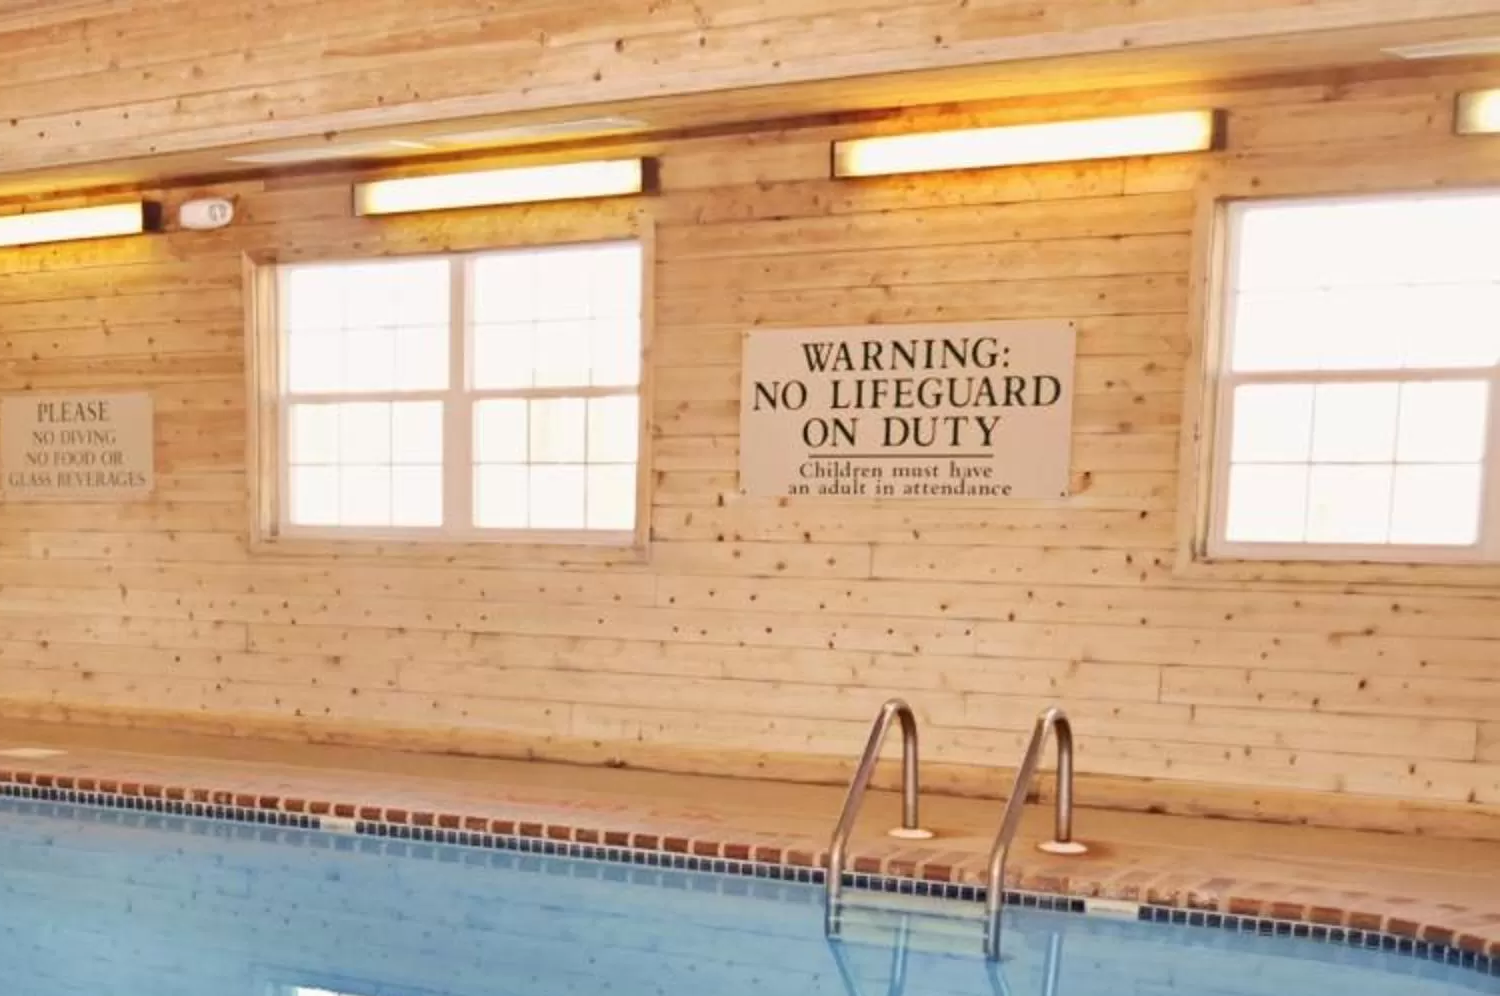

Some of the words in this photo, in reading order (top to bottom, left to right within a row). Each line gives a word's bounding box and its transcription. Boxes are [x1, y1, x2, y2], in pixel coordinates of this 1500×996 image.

[802, 337, 1010, 373] WARNING:
[753, 380, 807, 411] NO
[830, 375, 1061, 410] LIFEGUARD
[37, 401, 110, 423] PLEASE
[32, 430, 55, 445] NO
[60, 429, 117, 445] DIVING
[802, 416, 859, 448] ON
[882, 415, 1002, 447] DUTY
[25, 451, 49, 465] NO
[53, 451, 96, 466] FOOD
[101, 451, 123, 465] OR
[799, 460, 883, 479] Children
[891, 464, 939, 479] must
[949, 460, 994, 478] have
[8, 471, 52, 487] GLASS
[57, 471, 146, 488] BEVERAGES
[788, 483, 811, 495] an
[818, 480, 866, 495] adult
[875, 479, 895, 495] in
[902, 479, 1012, 496] attendance
